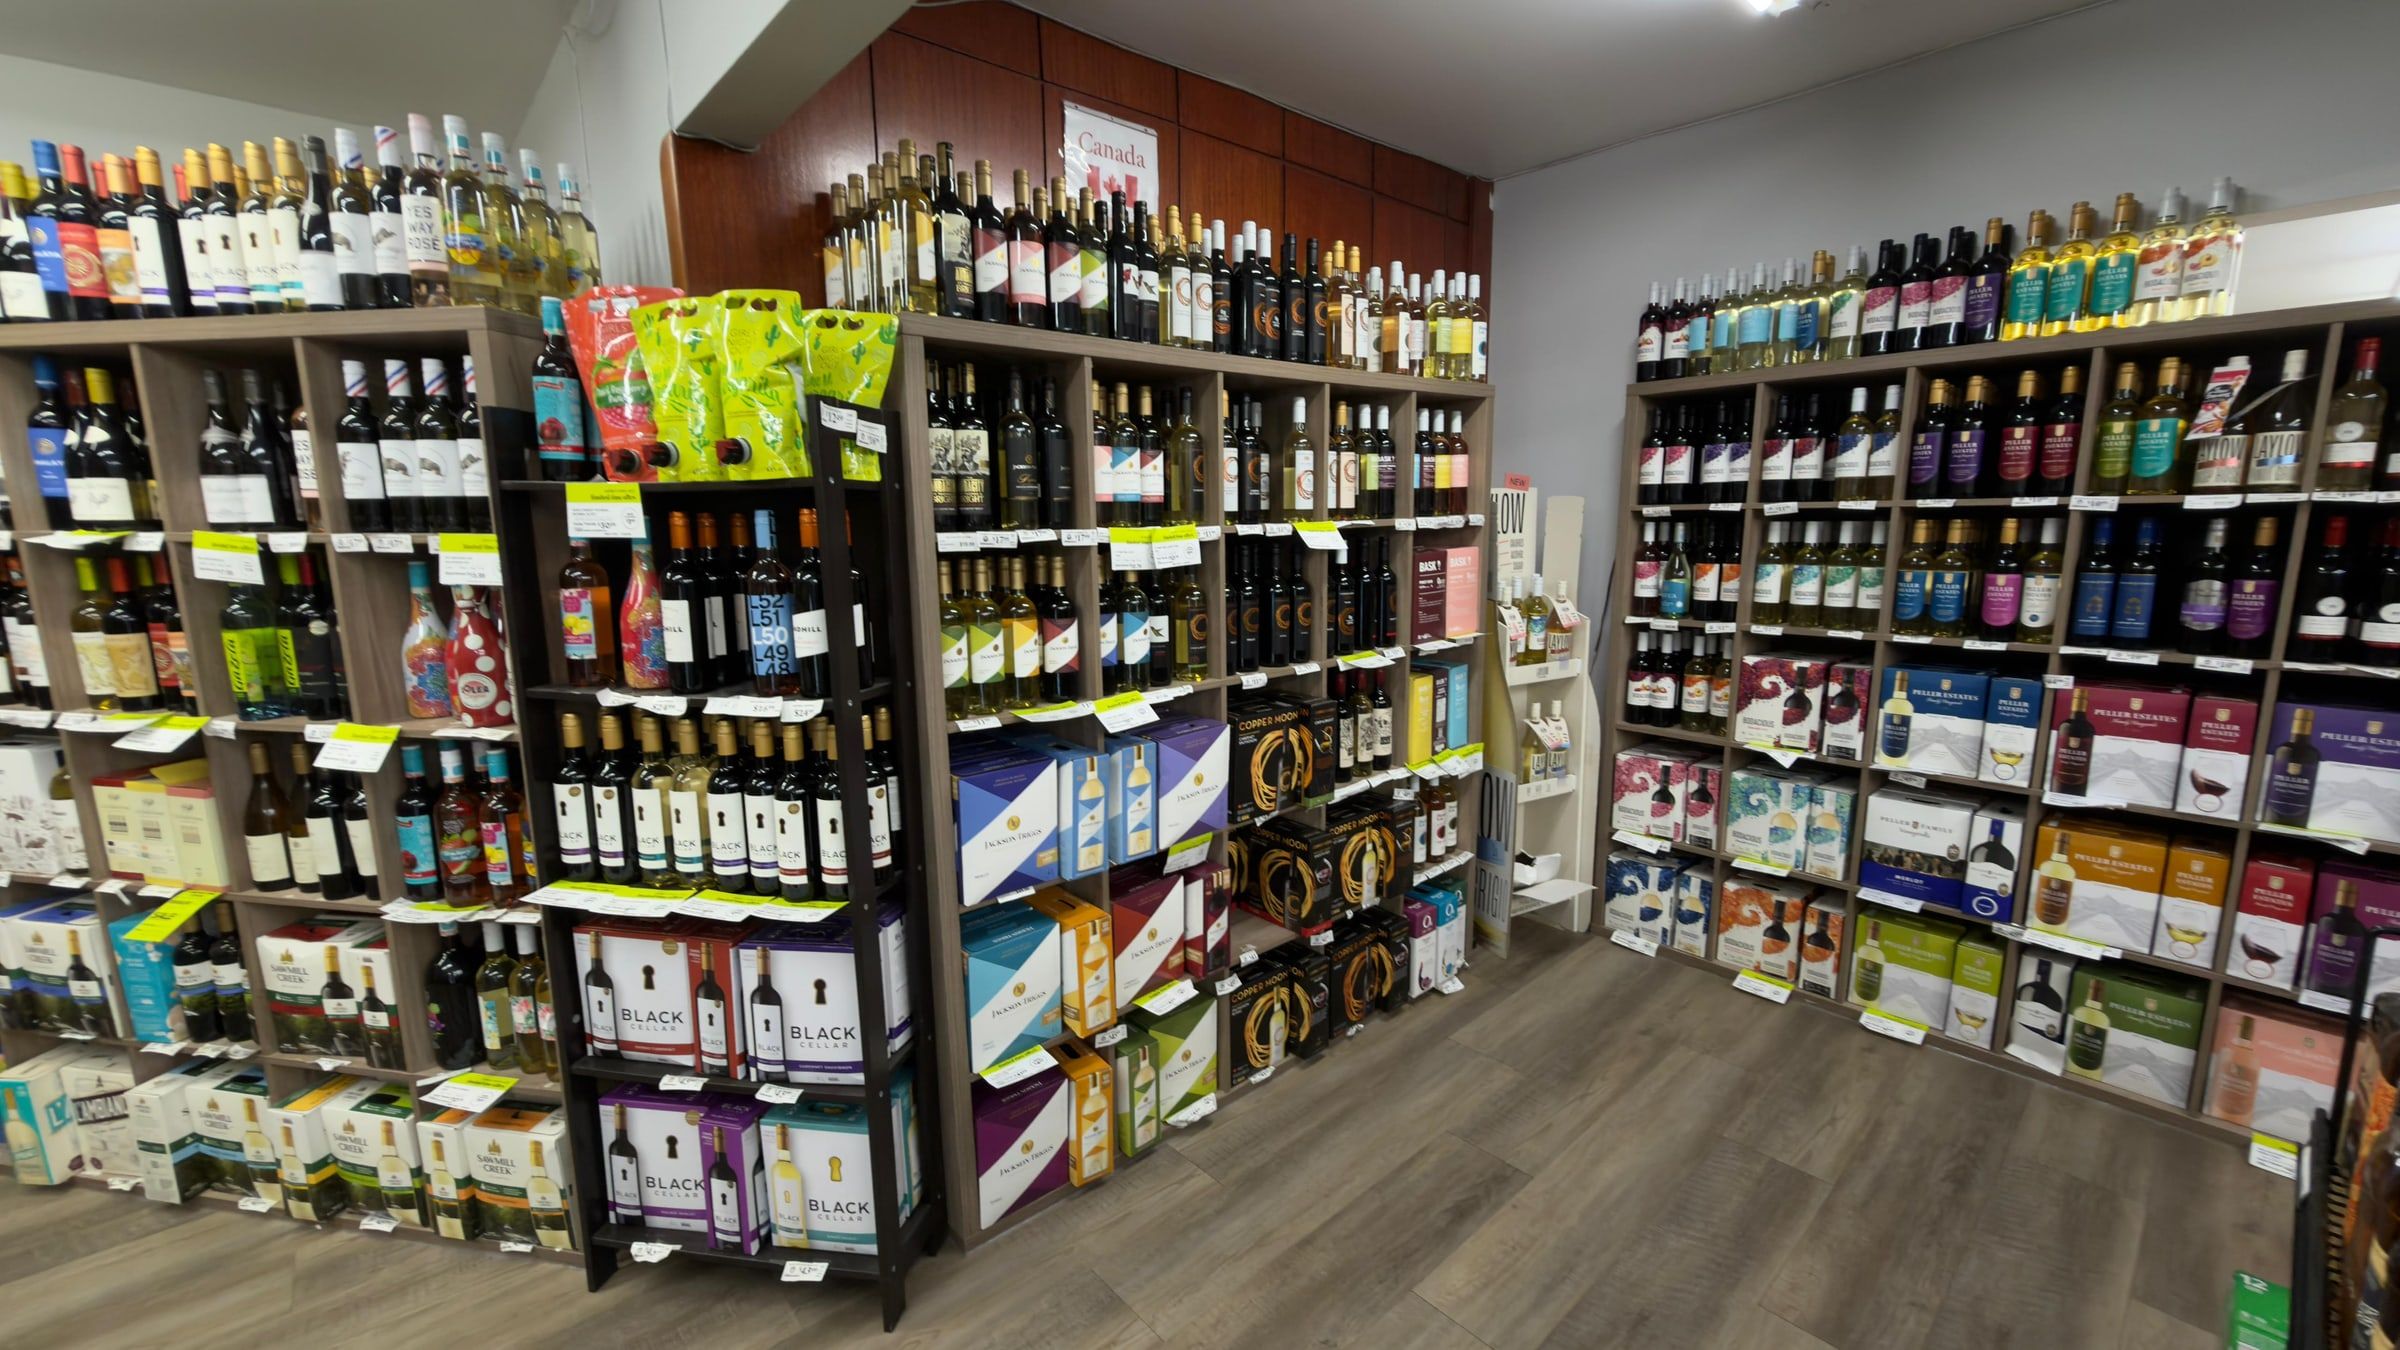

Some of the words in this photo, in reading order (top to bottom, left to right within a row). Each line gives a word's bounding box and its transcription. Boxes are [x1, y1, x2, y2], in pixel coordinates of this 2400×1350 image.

[1078, 131, 1147, 169] Canada
[406, 204, 433, 219] YES
[407, 221, 436, 236] WAY
[1509, 477, 1526, 487] NEW
[1419, 560, 1436, 572] BASK
[751, 594, 784, 609] L52
[752, 610, 781, 627] L51
[752, 627, 789, 645] L50
[754, 644, 789, 662] L49
[755, 661, 790, 676] L48
[1912, 689, 1943, 697] PELLER
[1943, 693, 1979, 701] ESTATES
[1998, 700, 2029, 708] PELLER
[1239, 717, 1274, 731] COPPER
[1274, 711, 1298, 724] MOON
[1743, 717, 1774, 728] BODACIOUS
[2094, 709, 2131, 719] PELLER
[2131, 713, 2178, 723] ESTATES
[2202, 722, 2240, 731] PELLER
[2320, 732, 2368, 743] PELLER
[1880, 816, 1910, 826] PELLER
[1920, 824, 1953, 833] FAMILY
[822, 850, 847, 858] BLAC
[2075, 853, 2111, 865] PELLER
[2254, 887, 2294, 900] PELLER
[270, 964, 309, 975] SAWMILL
[276, 974, 305, 983] CREEK
[1232, 983, 1264, 1002] COPPER
[1265, 970, 1288, 987] MOON
[621, 1008, 684, 1024] BLACK
[630, 1023, 678, 1031] CELLAR
[790, 1026, 857, 1040] BLACK
[799, 1041, 849, 1049] CELLAR
[332, 1133, 369, 1147] SAWMILL
[337, 1143, 365, 1154] CREEK
[476, 1154, 517, 1168] SAWMILL
[482, 1163, 512, 1175] CREEK
[645, 1176, 705, 1190] BLACK
[654, 1190, 699, 1198] CELLAR
[808, 1199, 870, 1215] BLACK
[817, 1214, 863, 1222] CELLAR
